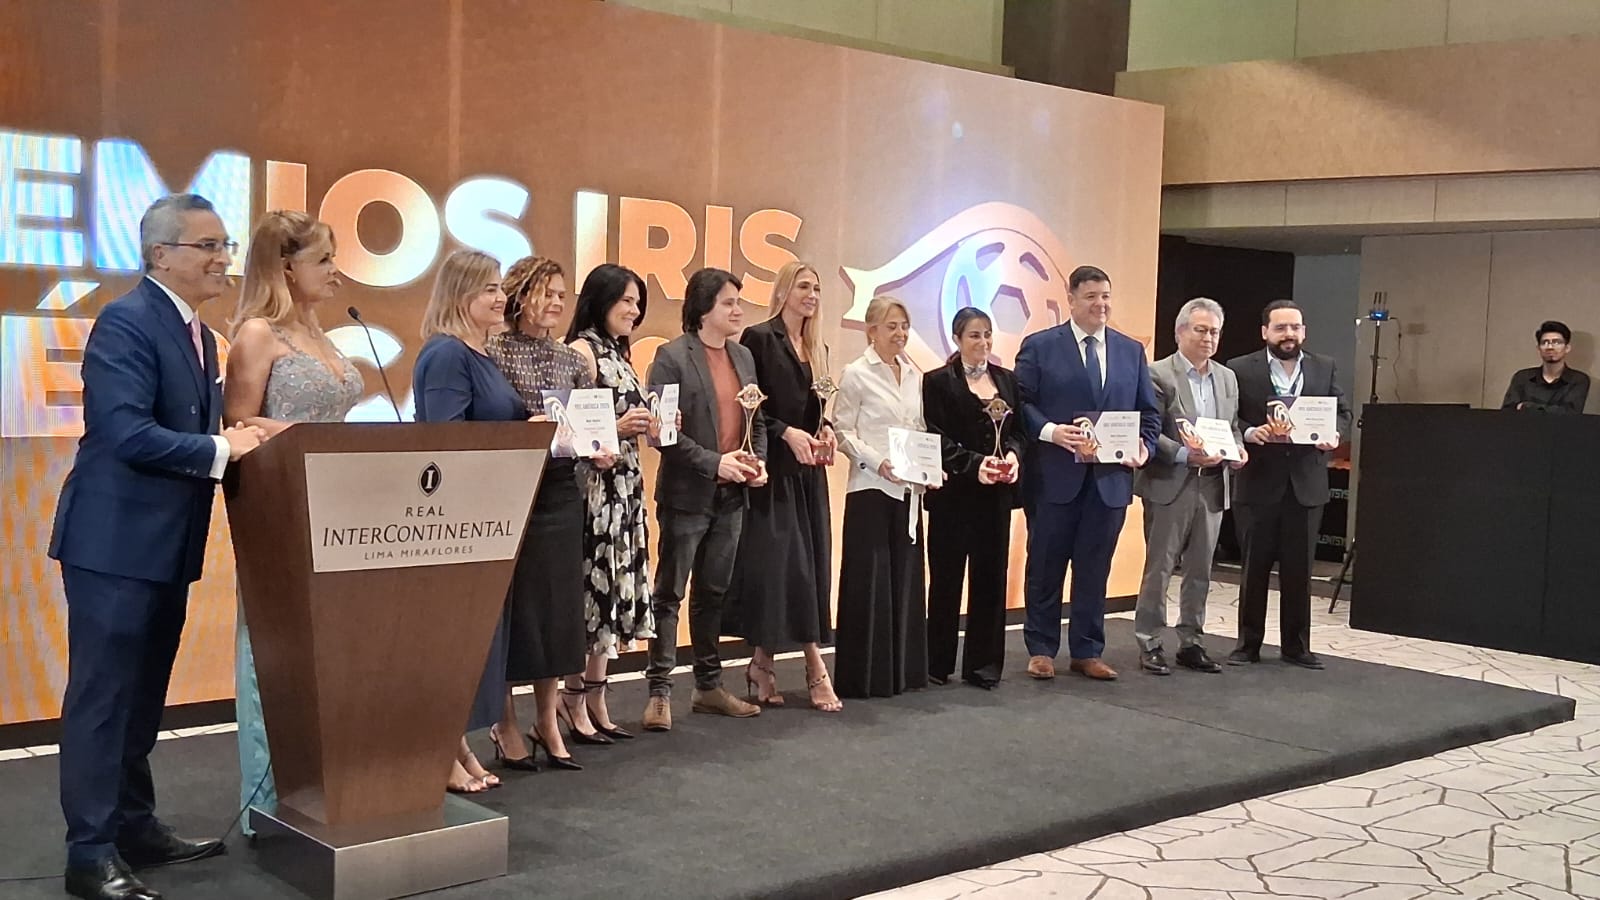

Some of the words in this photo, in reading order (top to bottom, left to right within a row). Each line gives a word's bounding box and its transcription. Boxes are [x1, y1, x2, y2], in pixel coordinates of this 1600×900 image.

[574, 190, 803, 307] IRIS
[405, 505, 445, 517] REAL
[364, 549, 394, 560] LIMA
[400, 545, 474, 558] MIRAFLORES
